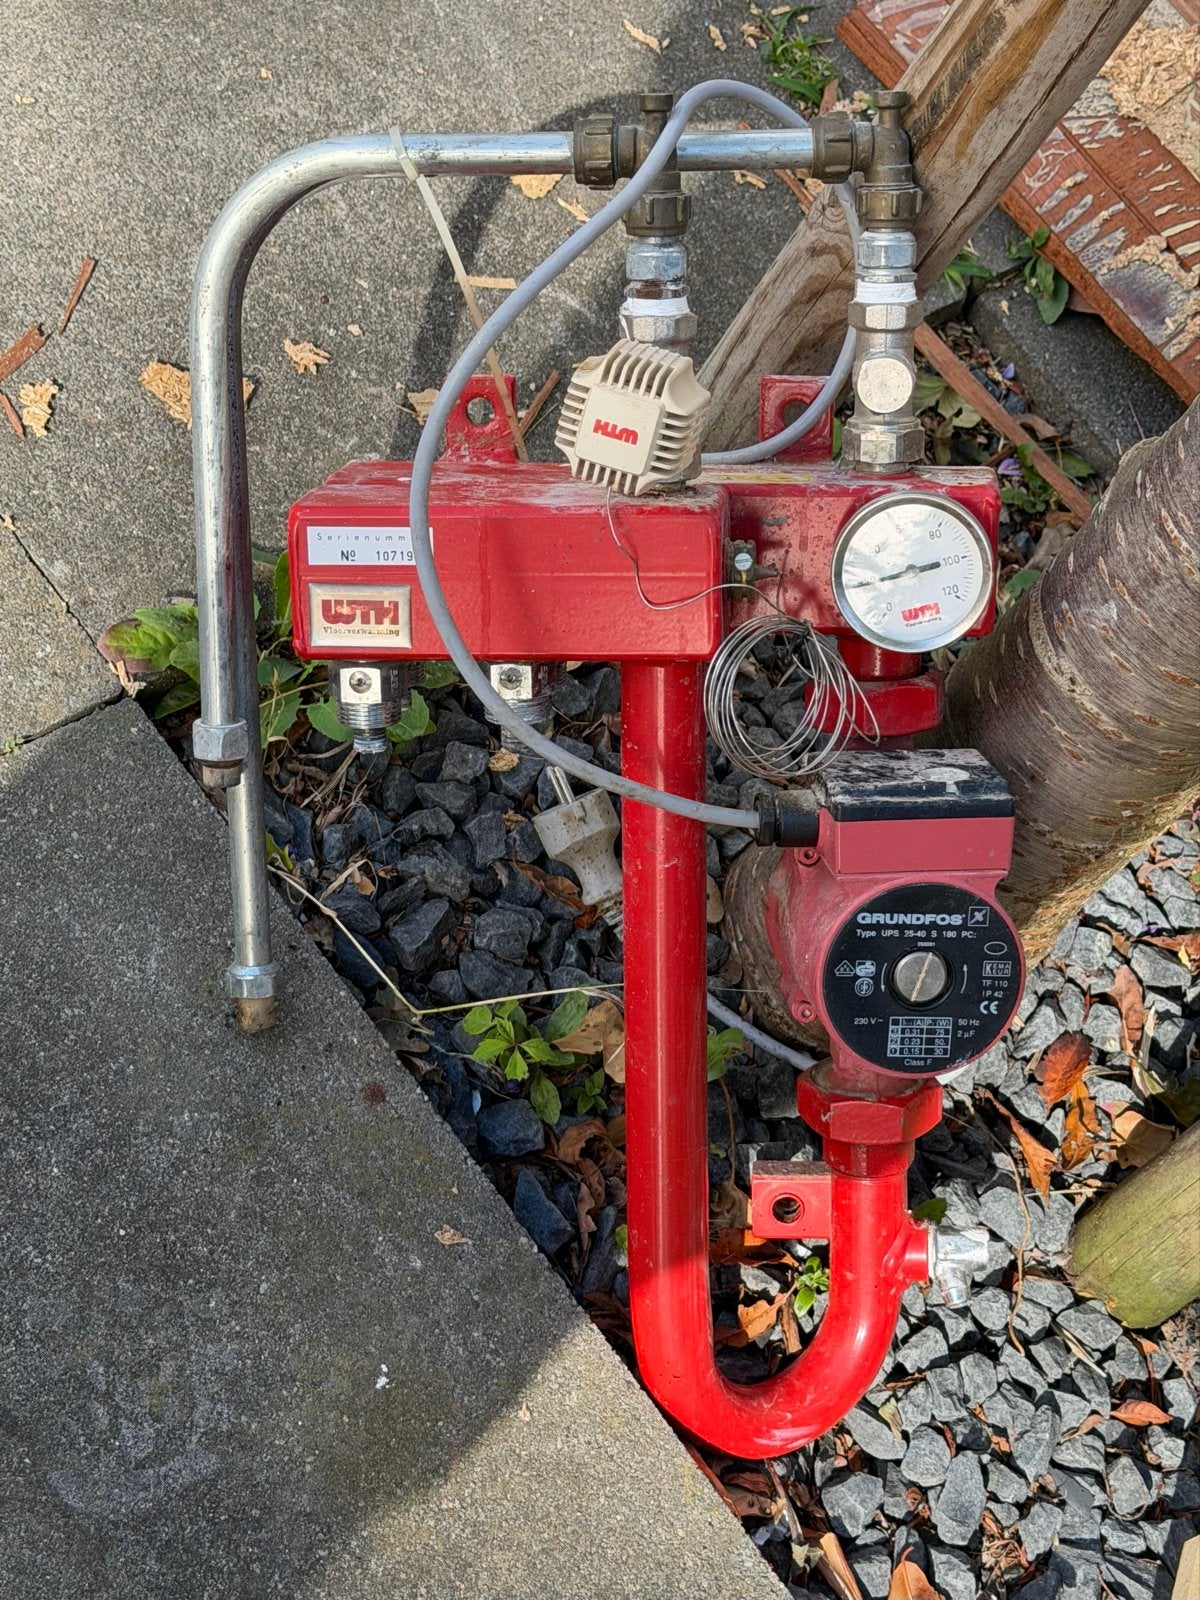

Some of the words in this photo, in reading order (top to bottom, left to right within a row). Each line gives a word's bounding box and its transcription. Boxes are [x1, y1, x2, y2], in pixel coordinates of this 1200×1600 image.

[317, 532, 406, 542] Serienumm
[928, 529, 943, 541] 80
[942, 554, 960, 567] 100
[942, 584, 960, 597] 120
[321, 599, 400, 625] WTH
[886, 602, 893, 612] 0
[901, 602, 941, 621] WTH
[857, 912, 963, 925] GRUNDFOS
[856, 929, 876, 939] Type
[881, 929, 899, 938] UPS
[904, 930, 927, 938] 25-40
[931, 930, 938, 938] S
[943, 930, 957, 938] 180
[961, 931, 977, 939] PC:
[995, 980, 1008, 988] 110
[993, 990, 1004, 998] 42
[854, 1017, 869, 1025] 230
[958, 1018, 968, 1026] 50
[969, 1018, 980, 1026] Hz
[935, 1028, 945, 1036] 75
[957, 1030, 963, 1038] 2
[903, 1047, 920, 1055] 0.15
[933, 1047, 944, 1055] 30
[904, 1058, 925, 1066] Class
